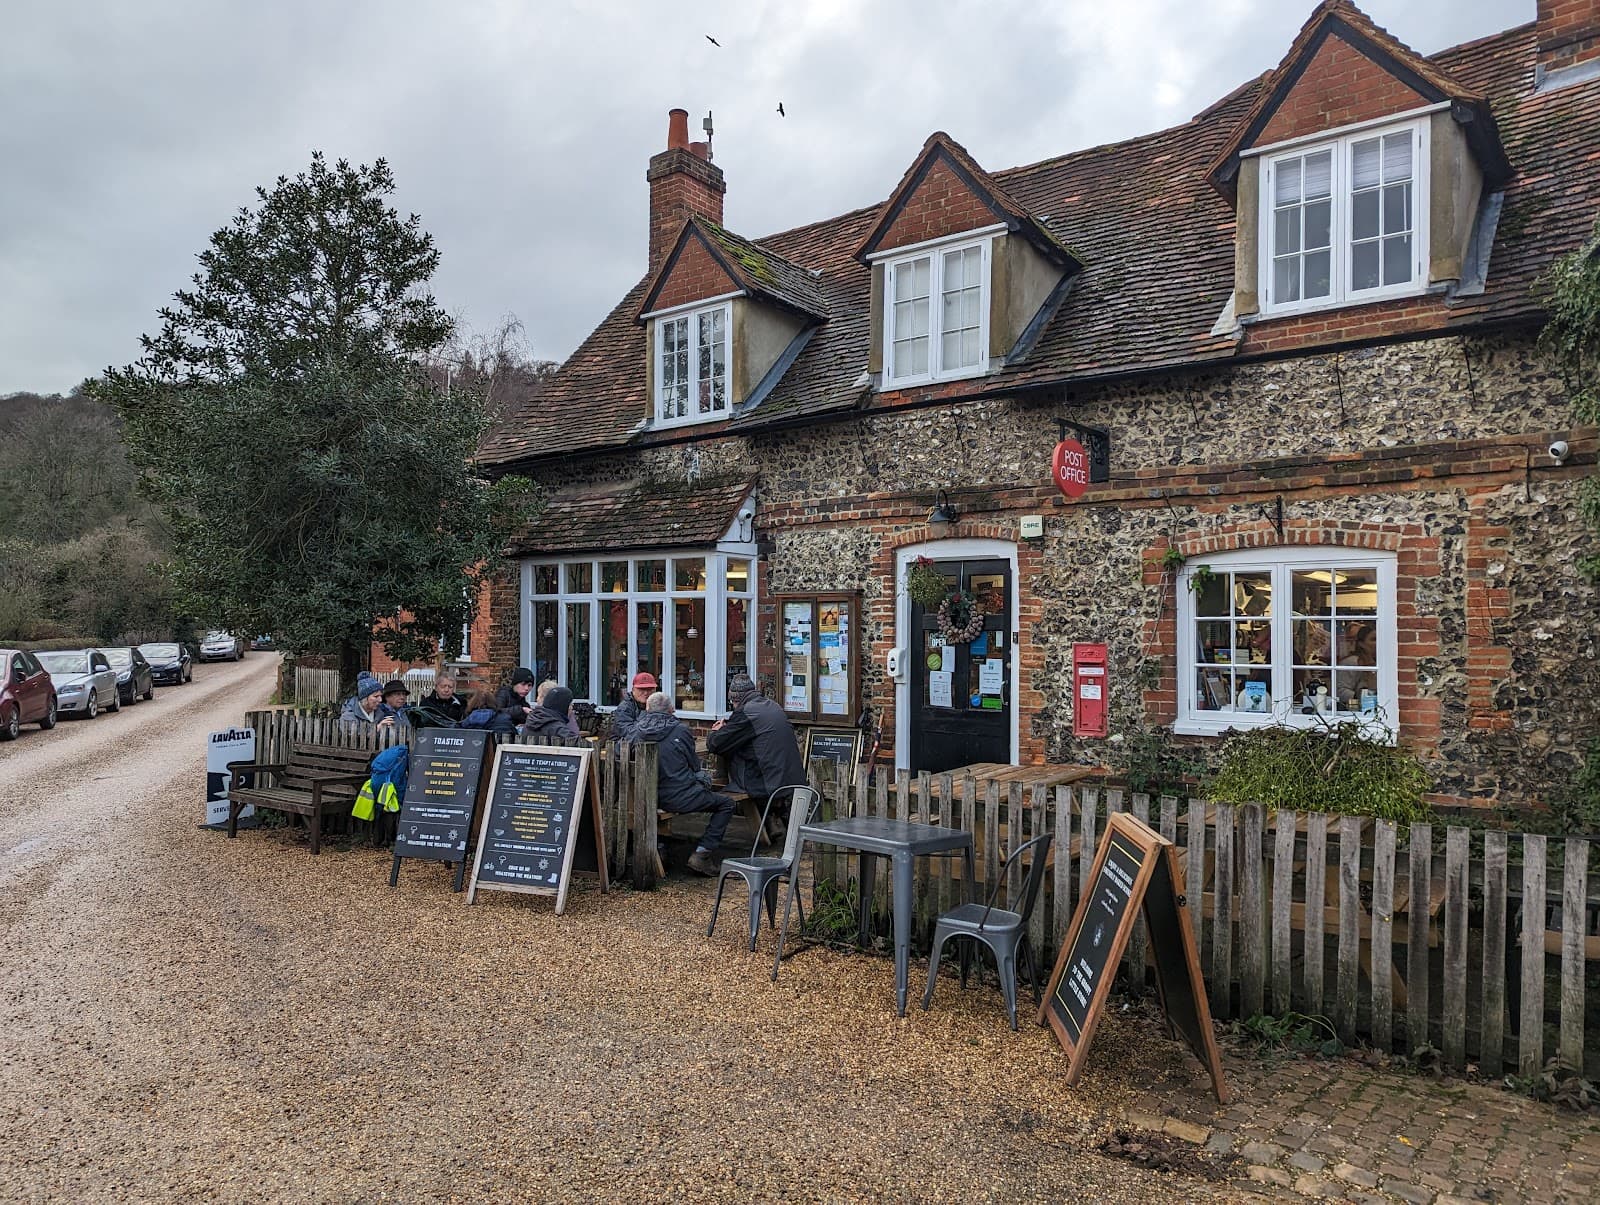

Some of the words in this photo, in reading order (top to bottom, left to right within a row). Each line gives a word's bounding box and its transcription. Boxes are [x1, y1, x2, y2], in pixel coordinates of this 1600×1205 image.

[1064, 450, 1083, 467] POST
[1060, 466, 1086, 484] OFFICE
[931, 638, 946, 647] OPEN
[212, 730, 251, 743] LAVAZZA
[434, 738, 464, 746] TOASTIES
